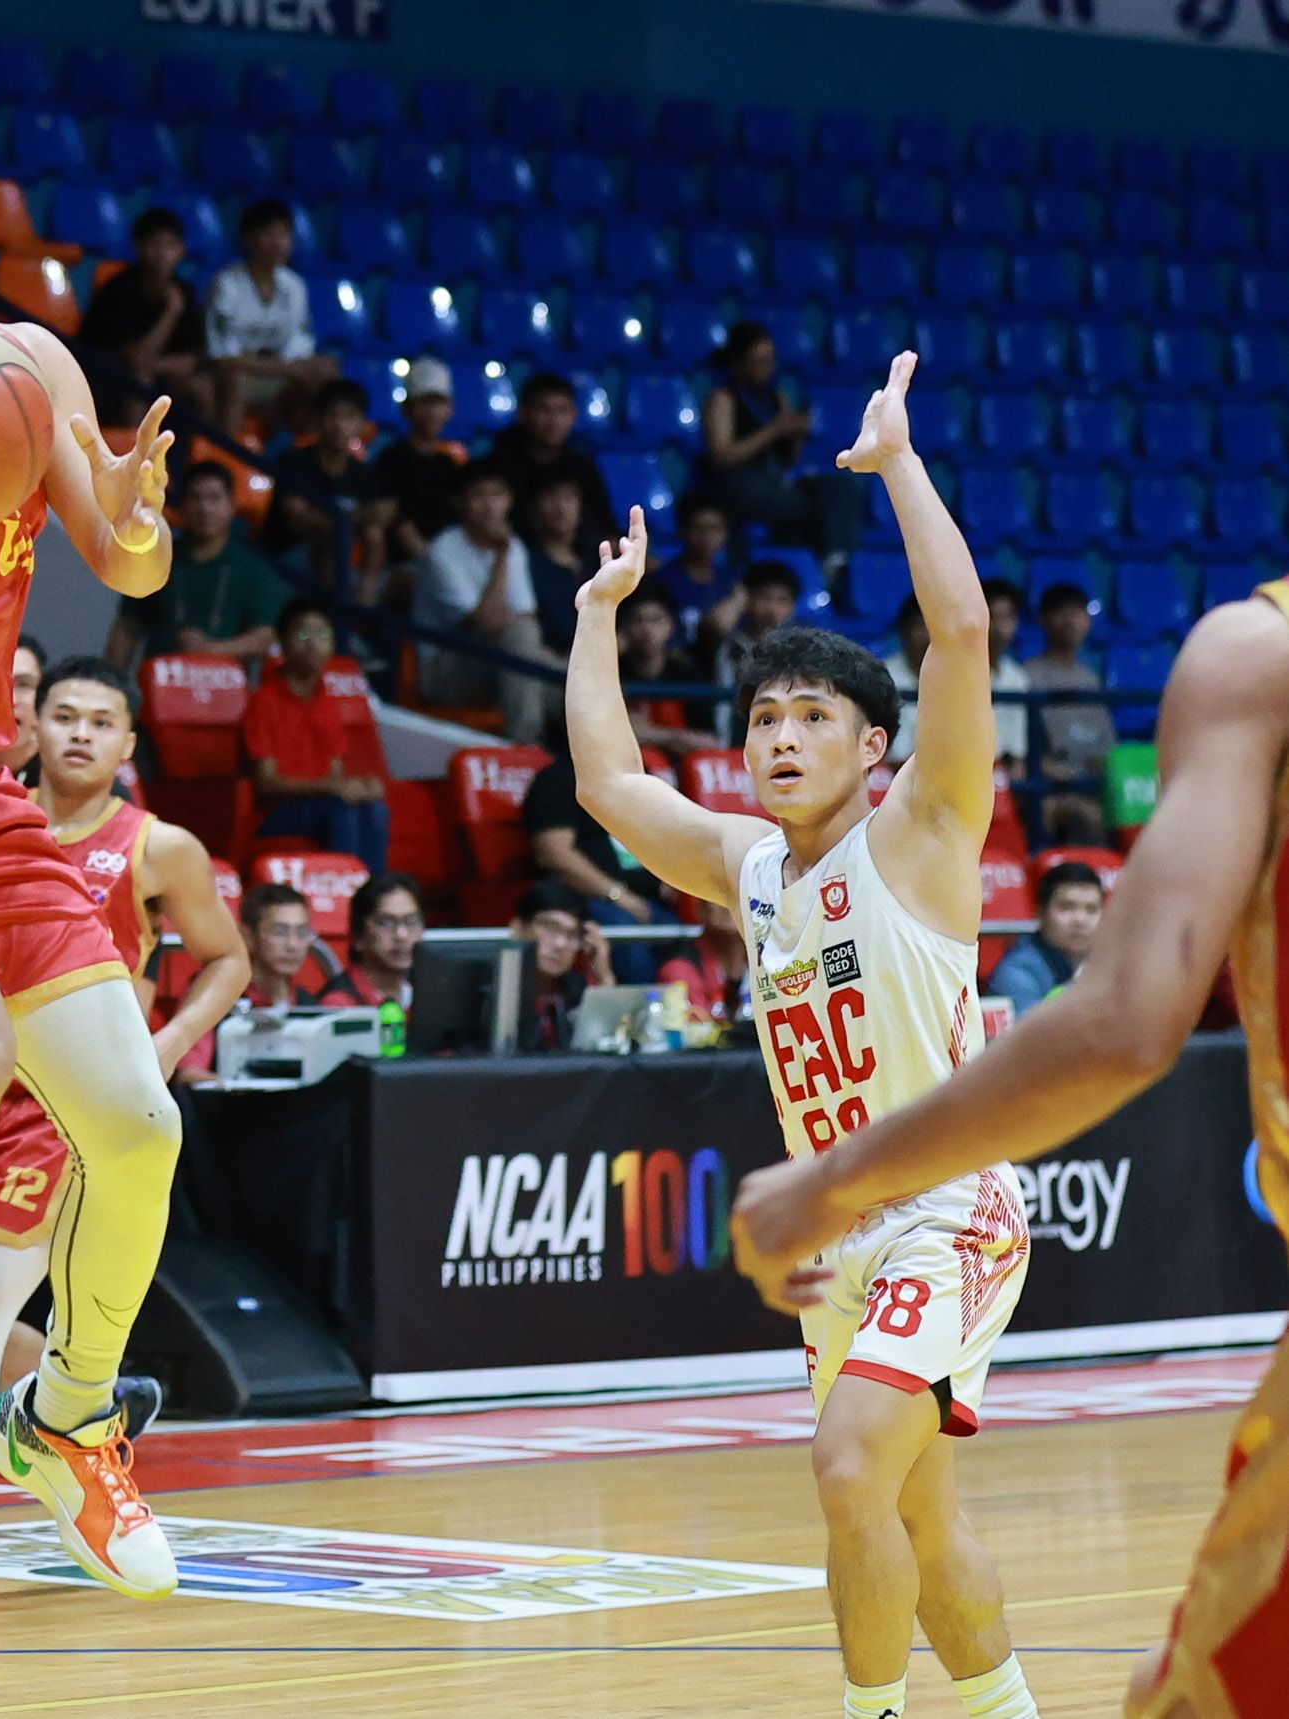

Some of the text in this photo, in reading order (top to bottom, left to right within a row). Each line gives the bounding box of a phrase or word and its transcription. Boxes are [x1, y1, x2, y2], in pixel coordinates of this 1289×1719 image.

[823, 944, 855, 963] CODE
[767, 986, 876, 1103] EAC
[444, 1147, 732, 1279] NCAA 100
[1013, 1157, 1132, 1252] ergy
[441, 1254, 603, 1289] PHILIPPINES
